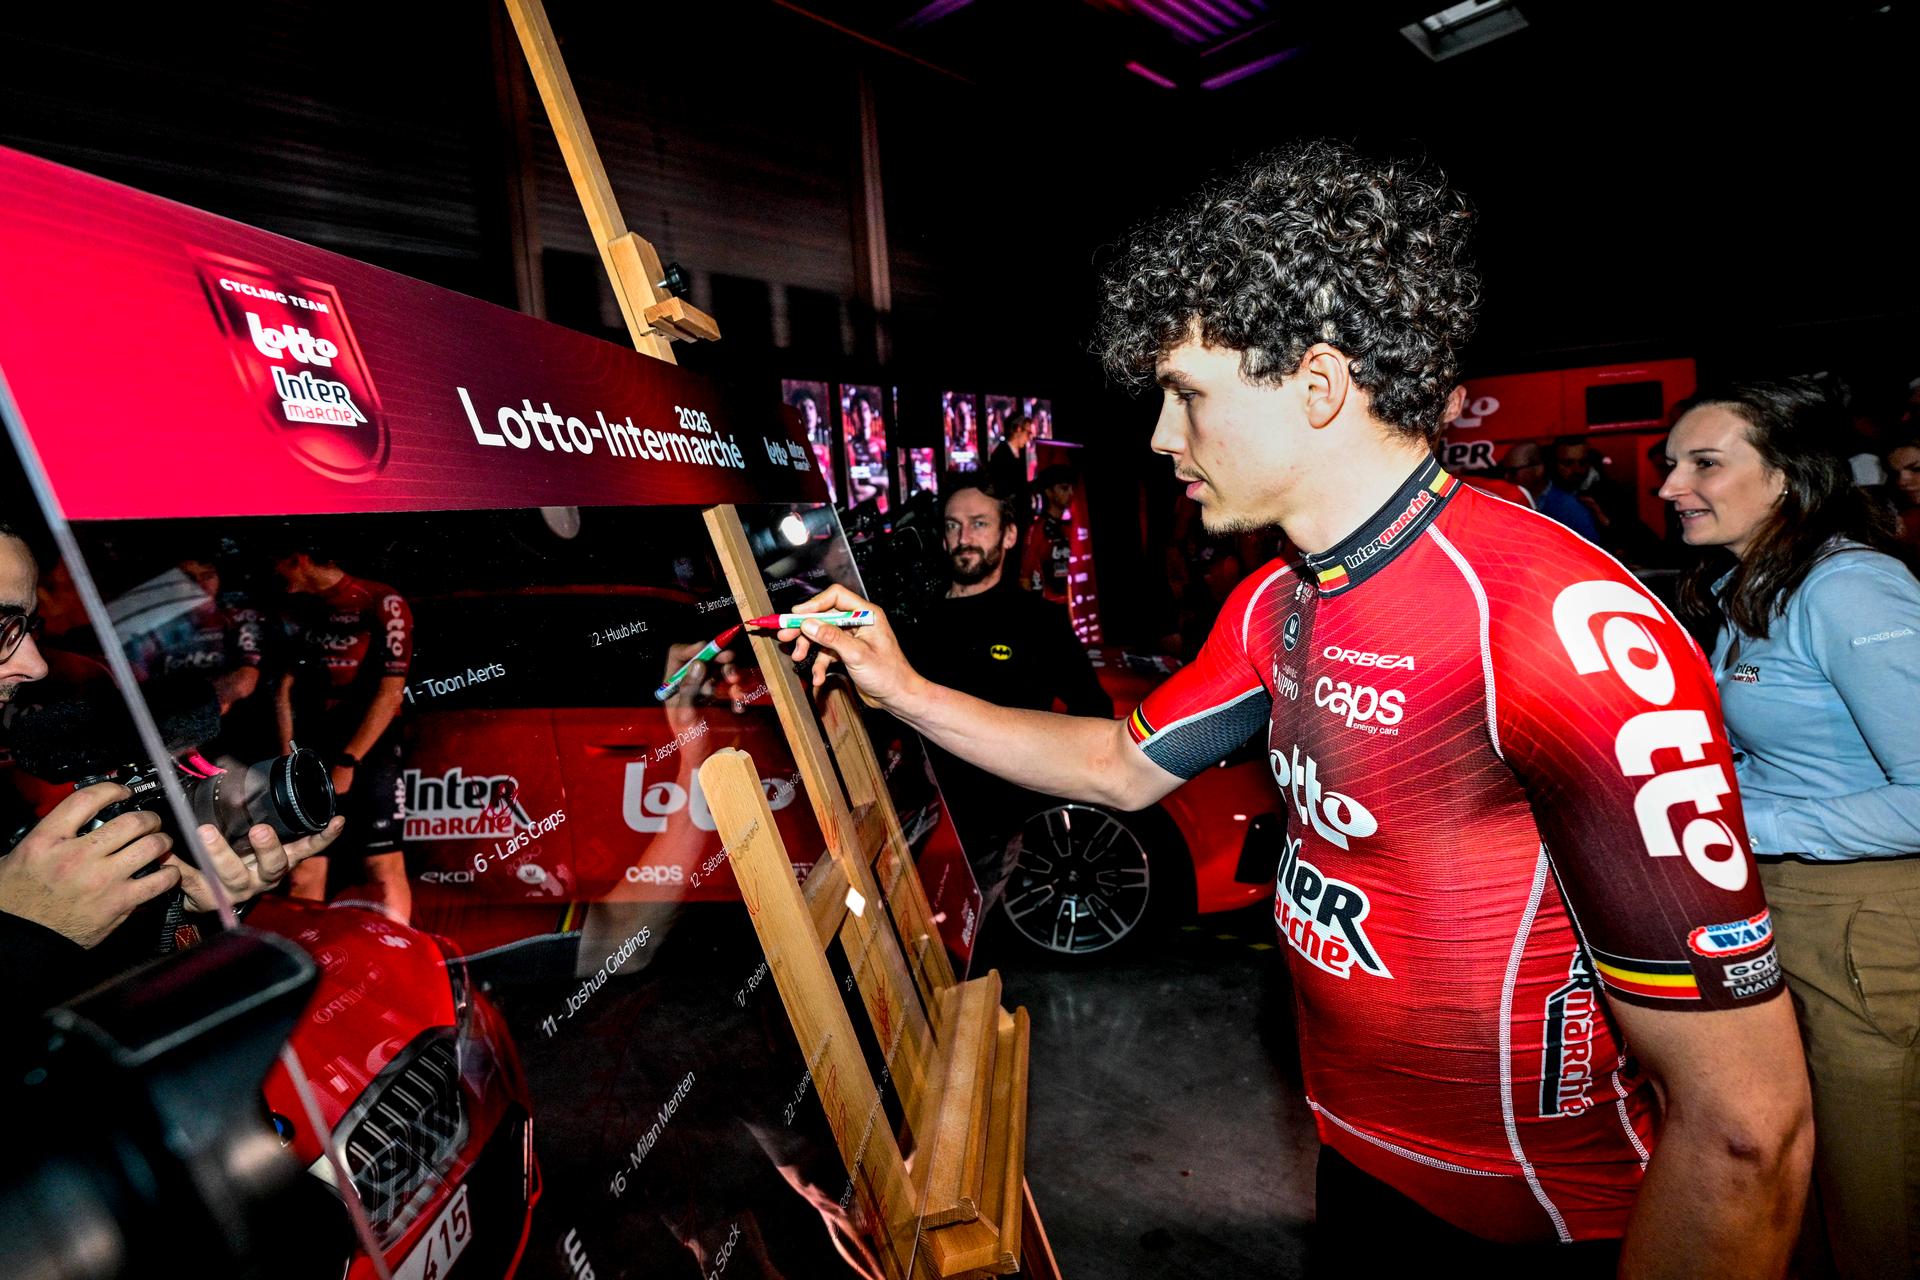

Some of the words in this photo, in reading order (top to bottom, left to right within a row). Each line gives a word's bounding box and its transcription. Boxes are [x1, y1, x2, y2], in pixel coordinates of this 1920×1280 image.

[219, 278, 287, 304] CYCLING
[288, 295, 329, 313] TEAM
[456, 386, 746, 470] Lotto-Intermarché
[674, 405, 712, 434] 2026
[706, 598, 722, 612] Jenno
[592, 632, 602, 646] 2
[606, 627, 630, 643] Huub
[630, 621, 649, 637] Artz
[1322, 645, 1416, 671] ORBEA
[403, 685, 416, 704] 1
[422, 675, 467, 697] Toon
[467, 663, 506, 686] Aerts
[1314, 675, 1407, 728] caps
[641, 754, 649, 769] 7
[655, 738, 680, 762] Jasper
[687, 719, 710, 742] Buyst
[1353, 721, 1379, 735] energy
[1379, 725, 1399, 736] card
[133, 780, 157, 794] FUJIFILM
[473, 851, 488, 873] 6
[495, 831, 529, 861] Lars
[528, 808, 566, 839] Craps
[625, 864, 684, 885] caps
[689, 872, 702, 889] 12
[541, 1014, 558, 1038] 11
[565, 968, 609, 1019] Joshua
[605, 924, 651, 975] Giddings
[737, 989, 748, 1008] 17
[747, 960, 768, 993] Robin
[784, 1102, 796, 1126] 22
[794, 1069, 812, 1103] Lione
[609, 1170, 627, 1198] 16
[630, 1122, 662, 1170] Milan
[657, 1070, 696, 1129] Menten
[715, 1221, 742, 1273] Slock
